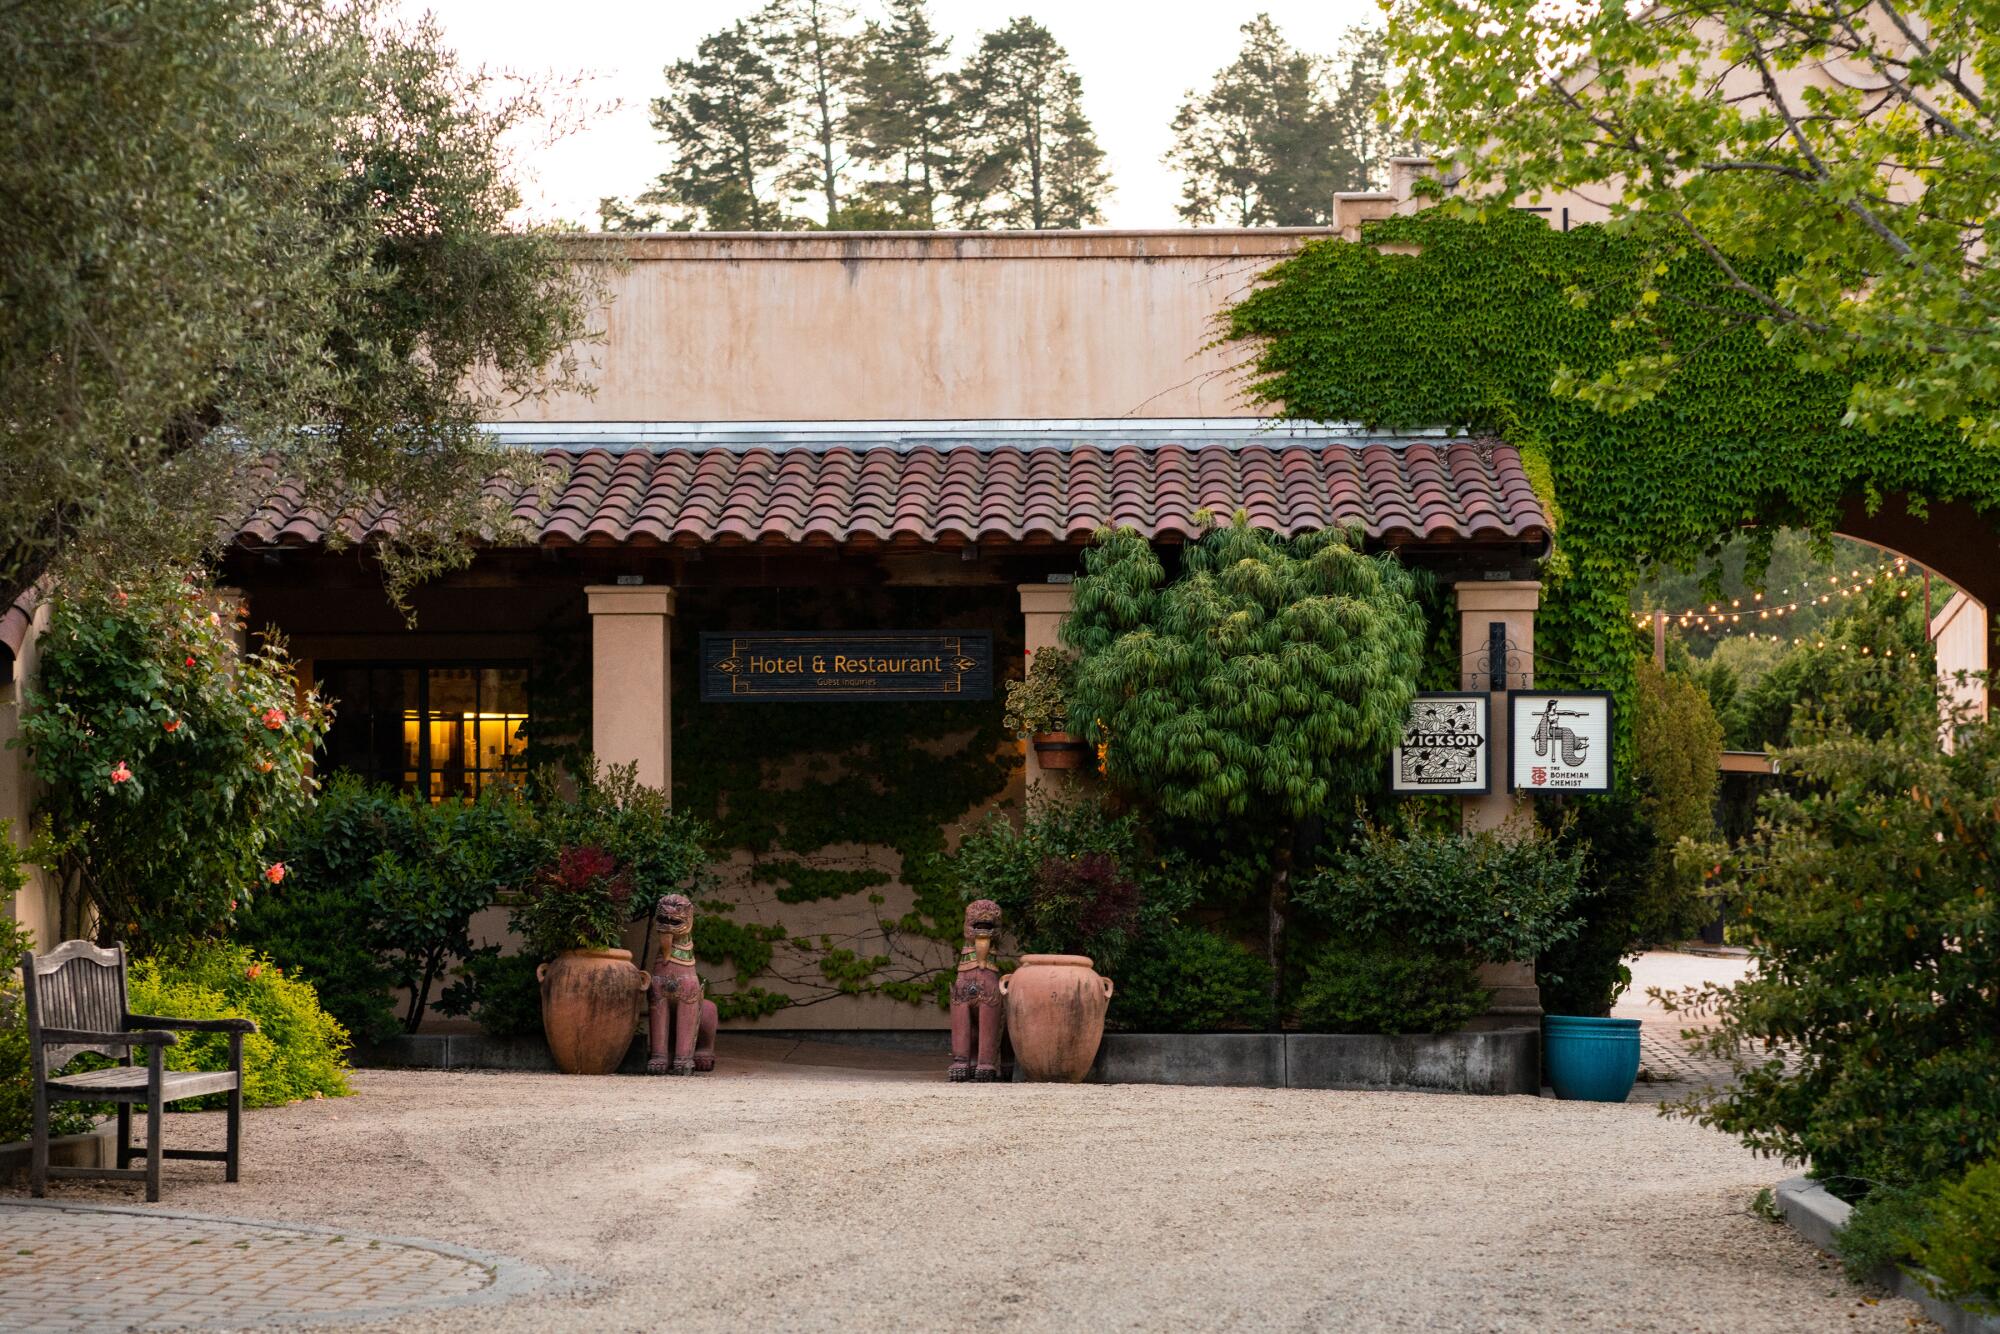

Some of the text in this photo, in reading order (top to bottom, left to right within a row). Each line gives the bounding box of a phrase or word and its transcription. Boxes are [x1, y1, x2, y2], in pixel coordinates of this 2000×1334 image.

[750, 655, 943, 674] Hotel & Restaurant
[817, 678, 840, 686] Guest
[1402, 735, 1479, 746] WICKSON
[1550, 779, 1582, 787] CHEMIST
